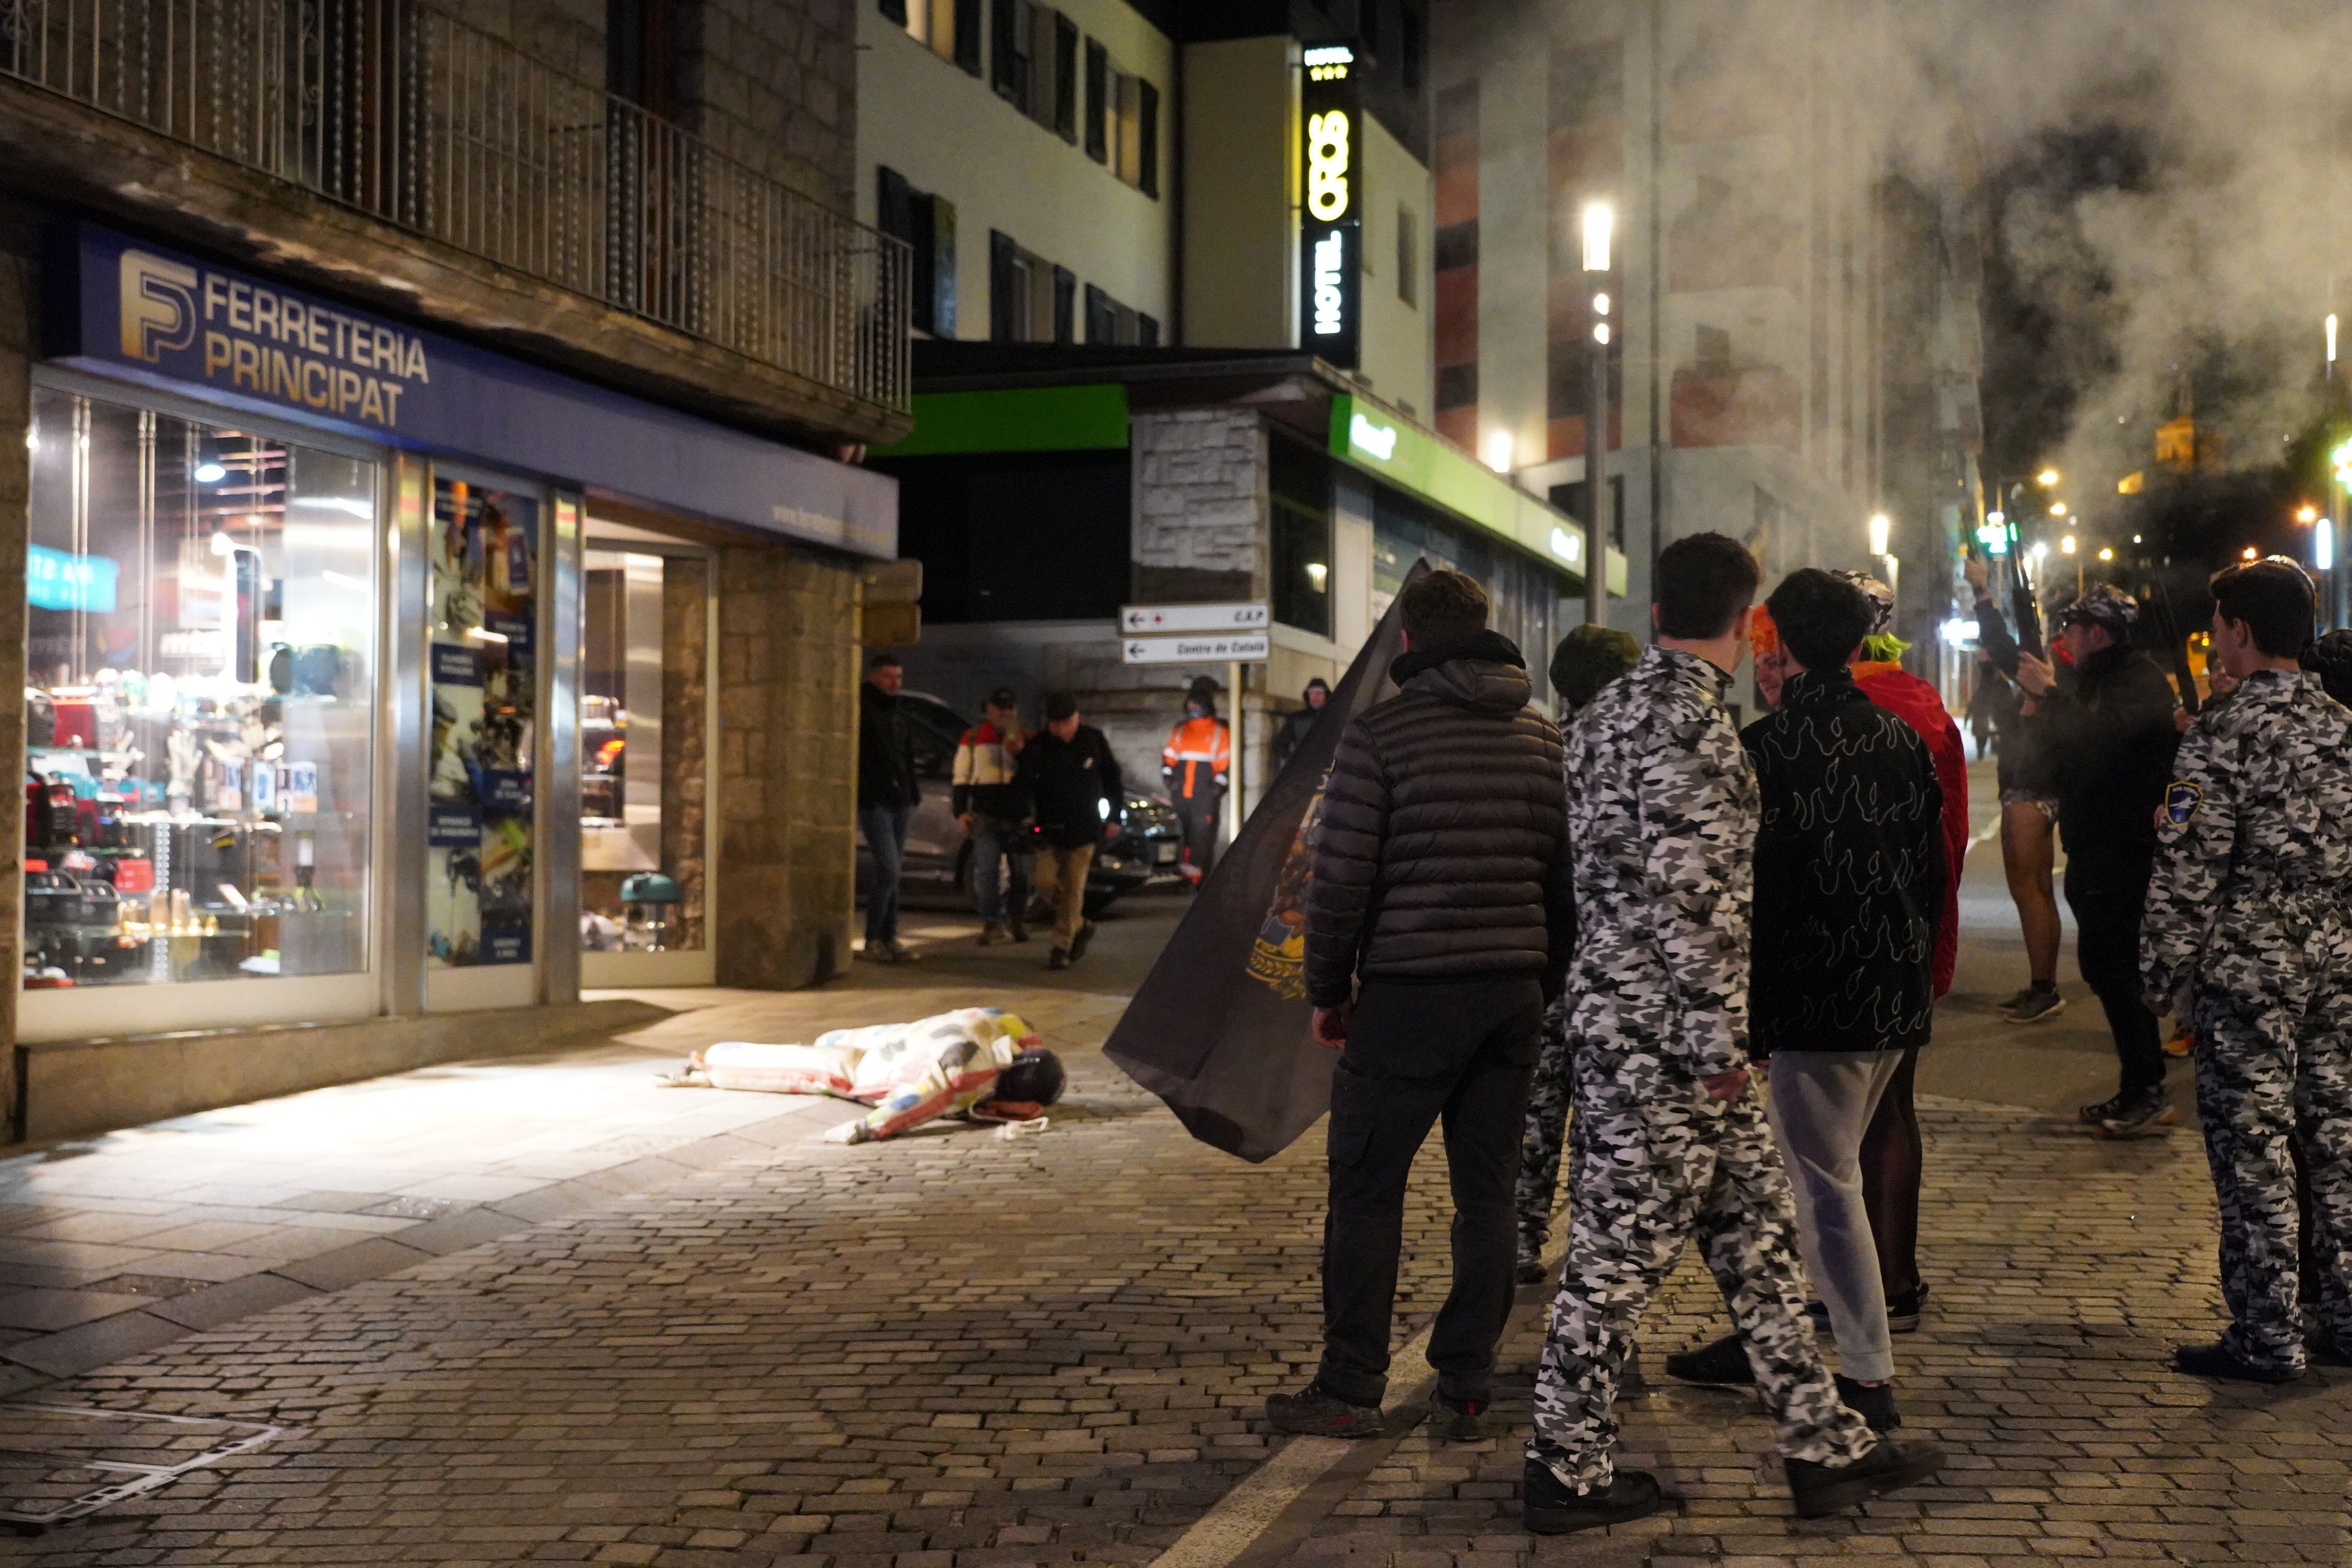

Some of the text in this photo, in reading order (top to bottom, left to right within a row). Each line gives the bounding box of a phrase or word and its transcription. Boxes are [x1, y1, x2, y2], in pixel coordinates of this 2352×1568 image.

[1307, 110, 1349, 335] HOTEL OROS
[204, 271, 429, 384] FERRETERIA
[204, 330, 403, 427] PRINCIPAT
